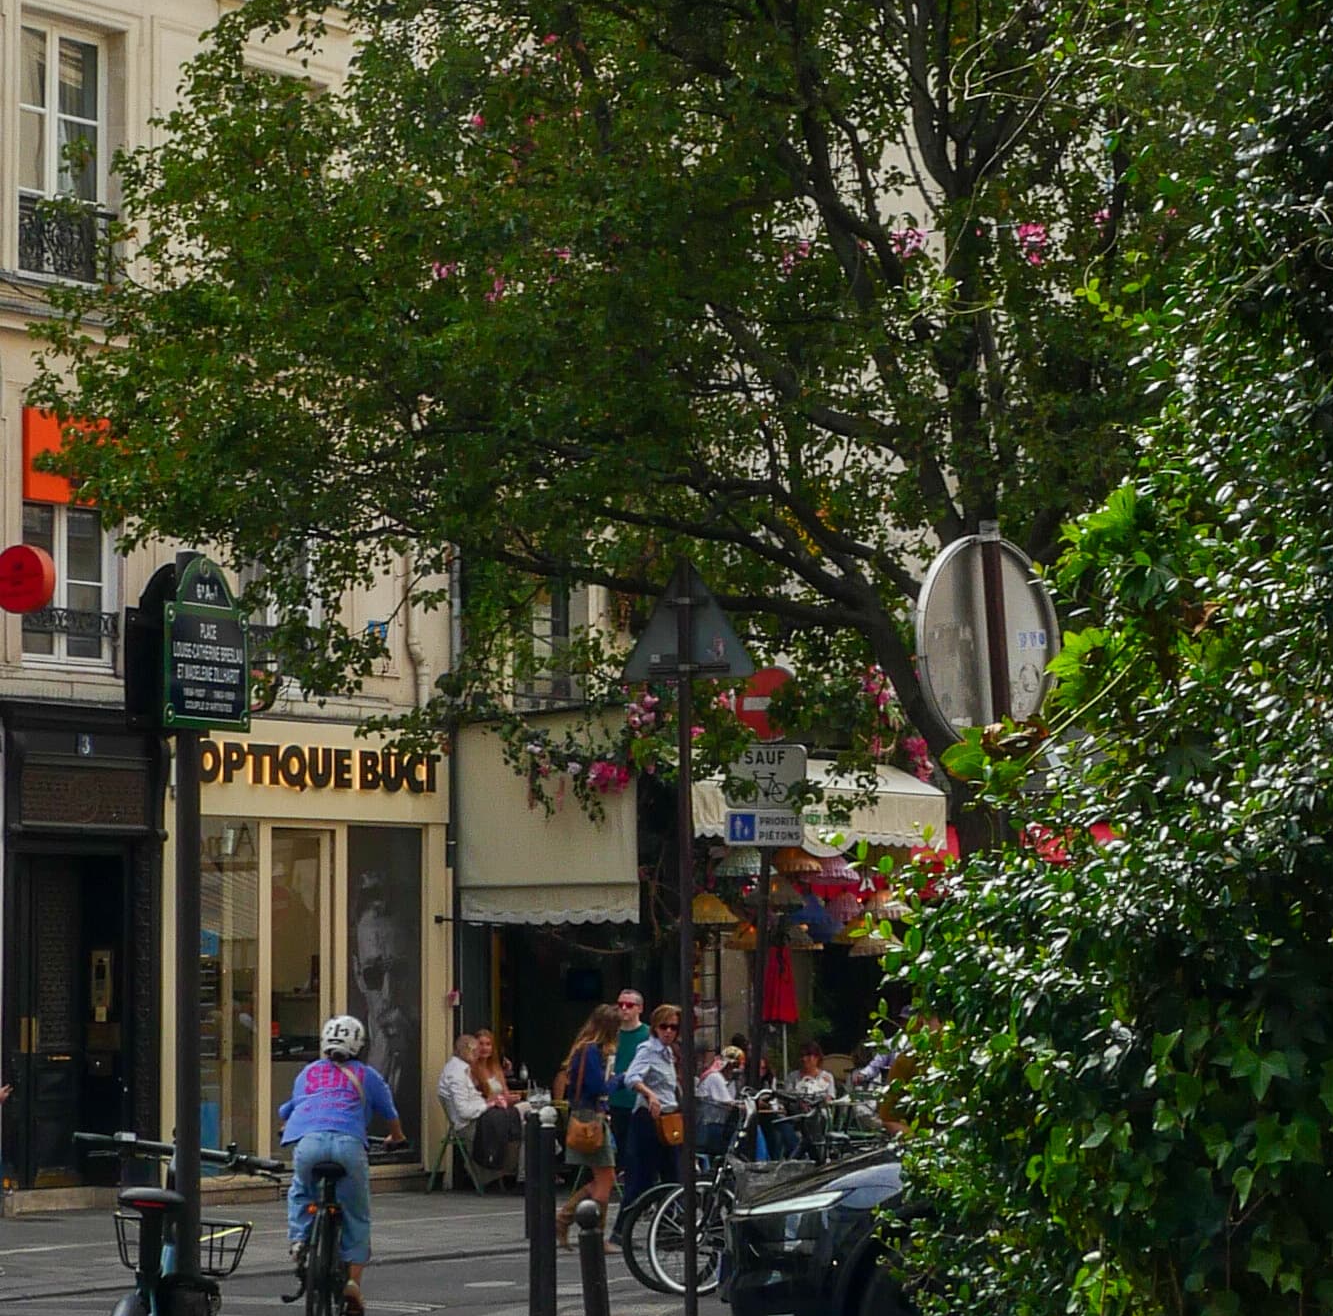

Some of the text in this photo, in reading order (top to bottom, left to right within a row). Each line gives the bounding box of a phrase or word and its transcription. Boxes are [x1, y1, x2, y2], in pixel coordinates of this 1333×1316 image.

[81, 735, 91, 754] 3
[199, 740, 441, 793] OPTIQUE BUCI
[744, 750, 785, 765] SAUF
